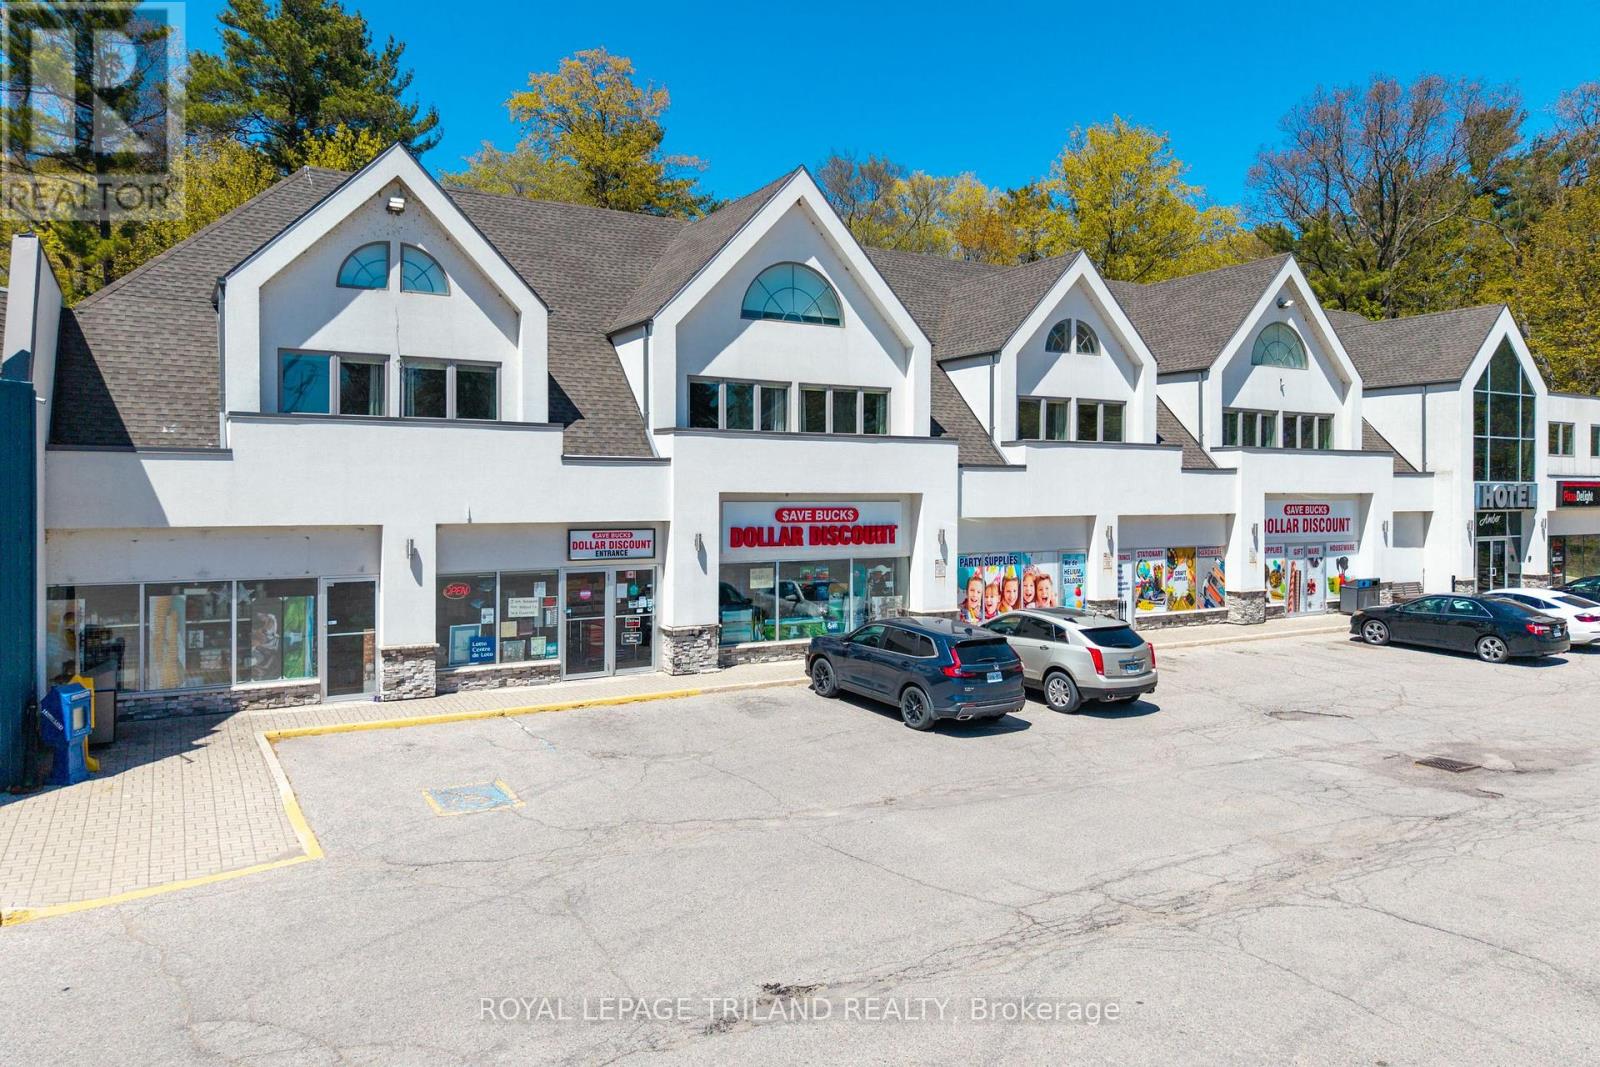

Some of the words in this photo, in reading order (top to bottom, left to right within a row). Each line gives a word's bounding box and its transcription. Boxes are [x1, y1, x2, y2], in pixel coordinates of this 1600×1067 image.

[1482, 485, 1536, 508] HOTEL
[1303, 517, 1351, 532] DISCOUNT
[730, 526, 804, 548] DOLLAR
[809, 525, 898, 546] DISCOUNT
[572, 541, 606, 550] DOLLAR
[609, 540, 651, 549] DISCOUNT
[1264, 546, 1282, 554] UPPLIES
[960, 557, 981, 568] PARTY
[984, 555, 1018, 567] SUPPLIES
